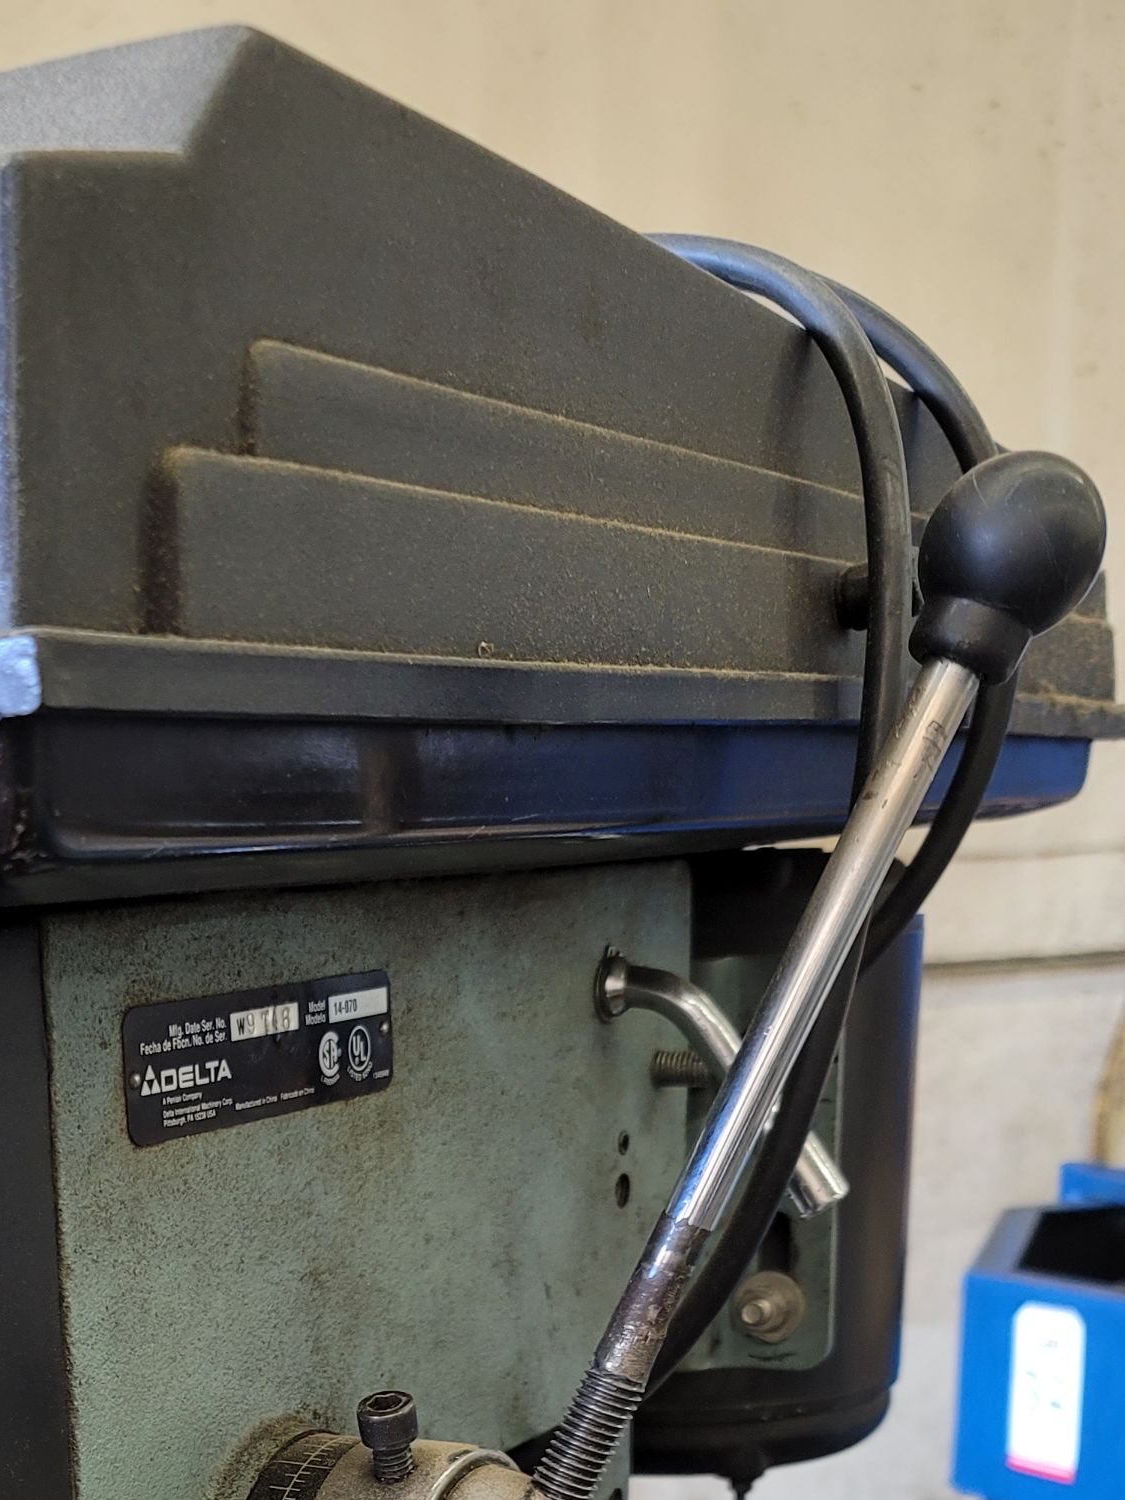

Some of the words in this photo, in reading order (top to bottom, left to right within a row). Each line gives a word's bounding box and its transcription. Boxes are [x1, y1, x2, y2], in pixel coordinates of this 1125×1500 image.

[308, 1000, 325, 1012] Model
[334, 998, 358, 1015] 14-070
[185, 1021, 201, 1035] Date
[201, 1019, 214, 1032] Ser.
[215, 1017, 227, 1029] No.
[305, 1013, 326, 1026] Modelo
[140, 1042, 161, 1055] Fecha
[162, 1040, 171, 1052] de
[193, 1034, 204, 1046] No.
[205, 1032, 214, 1044] de
[215, 1030, 227, 1043] Ser.
[160, 1059, 232, 1093] DELTA
